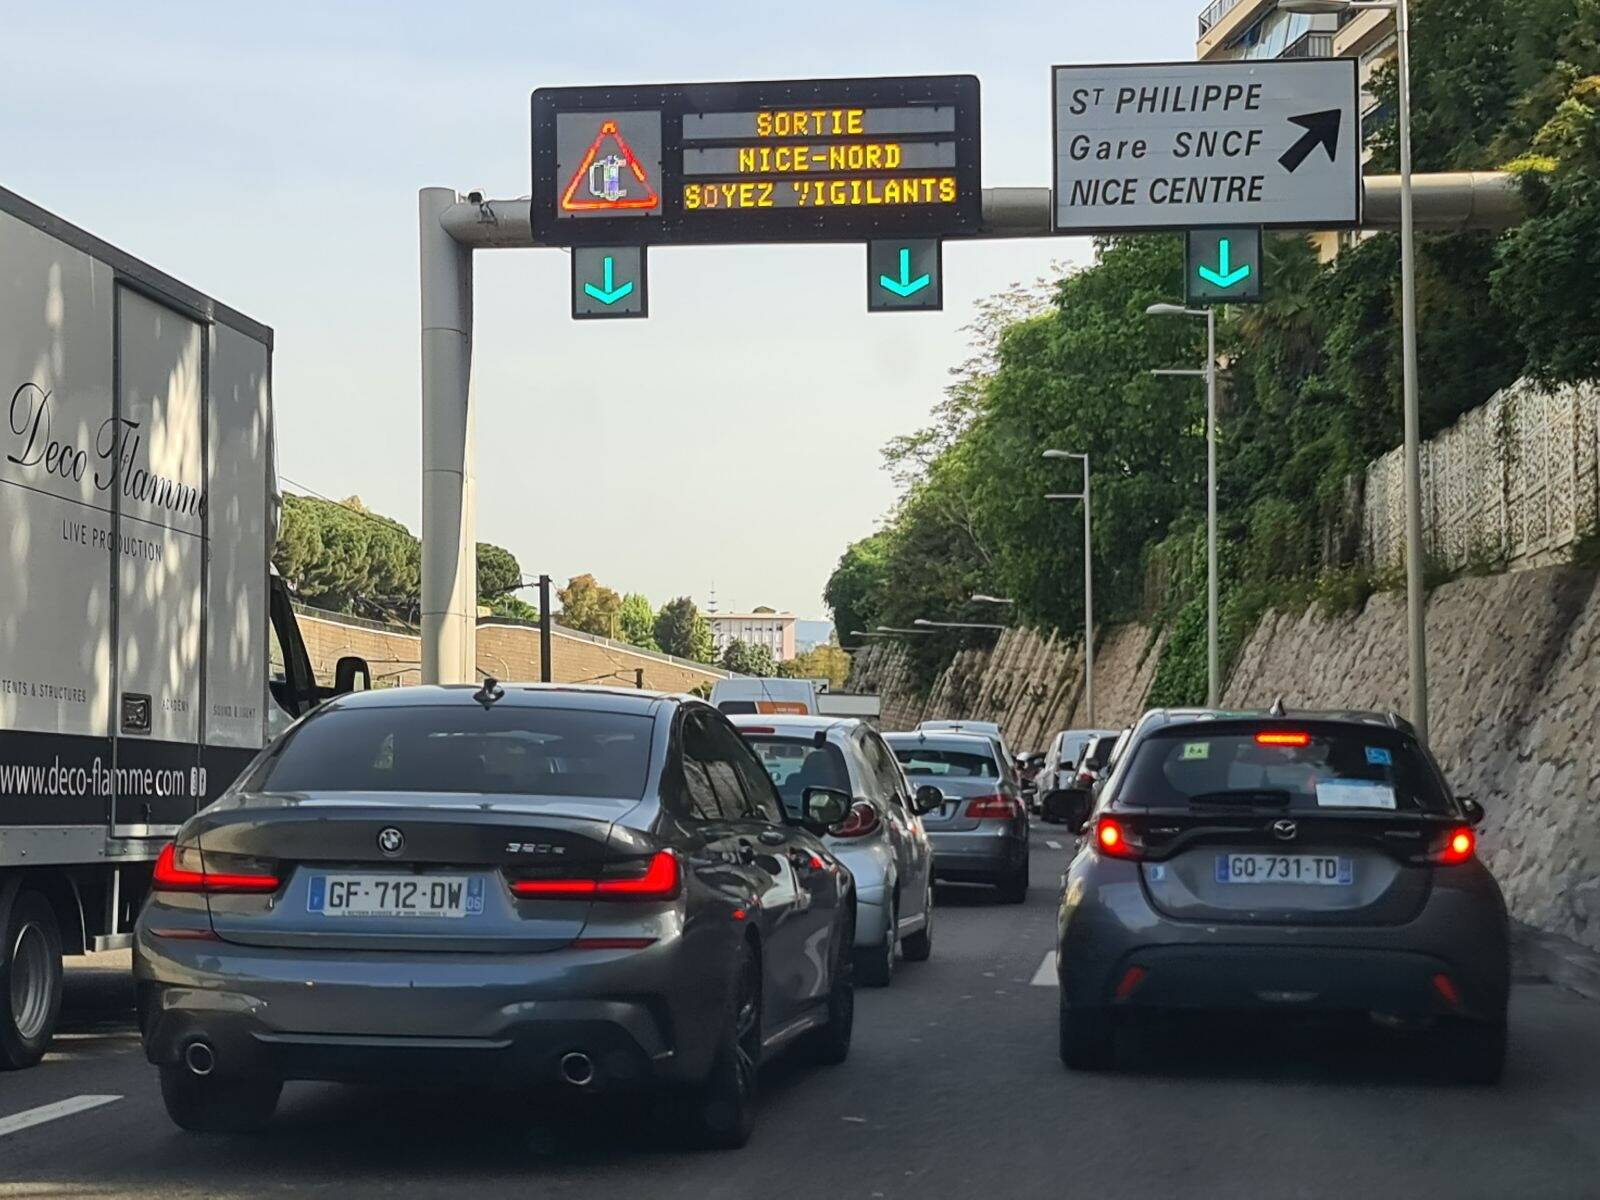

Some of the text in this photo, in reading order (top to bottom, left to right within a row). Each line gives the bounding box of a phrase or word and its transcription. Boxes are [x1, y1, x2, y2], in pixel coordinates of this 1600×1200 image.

[1115, 83, 1262, 113] PHILIPPE
[757, 110, 864, 136] SORTIE
[738, 144, 901, 172] NICE-NORD
[1069, 129, 1263, 161] Gare SNCF
[684, 178, 956, 209] SOYEZ VIGILANTS
[1070, 176, 1264, 206] NICE CENTRE
[8, 382, 88, 482] Deco
[62, 519, 162, 562] LIVE PRODUCTION
[2, 680, 27, 696] TENTS
[39, 684, 87, 702] STRUCTURES
[0, 755, 185, 796] www.deco-flammecom
[329, 881, 462, 909] GF-712-DW
